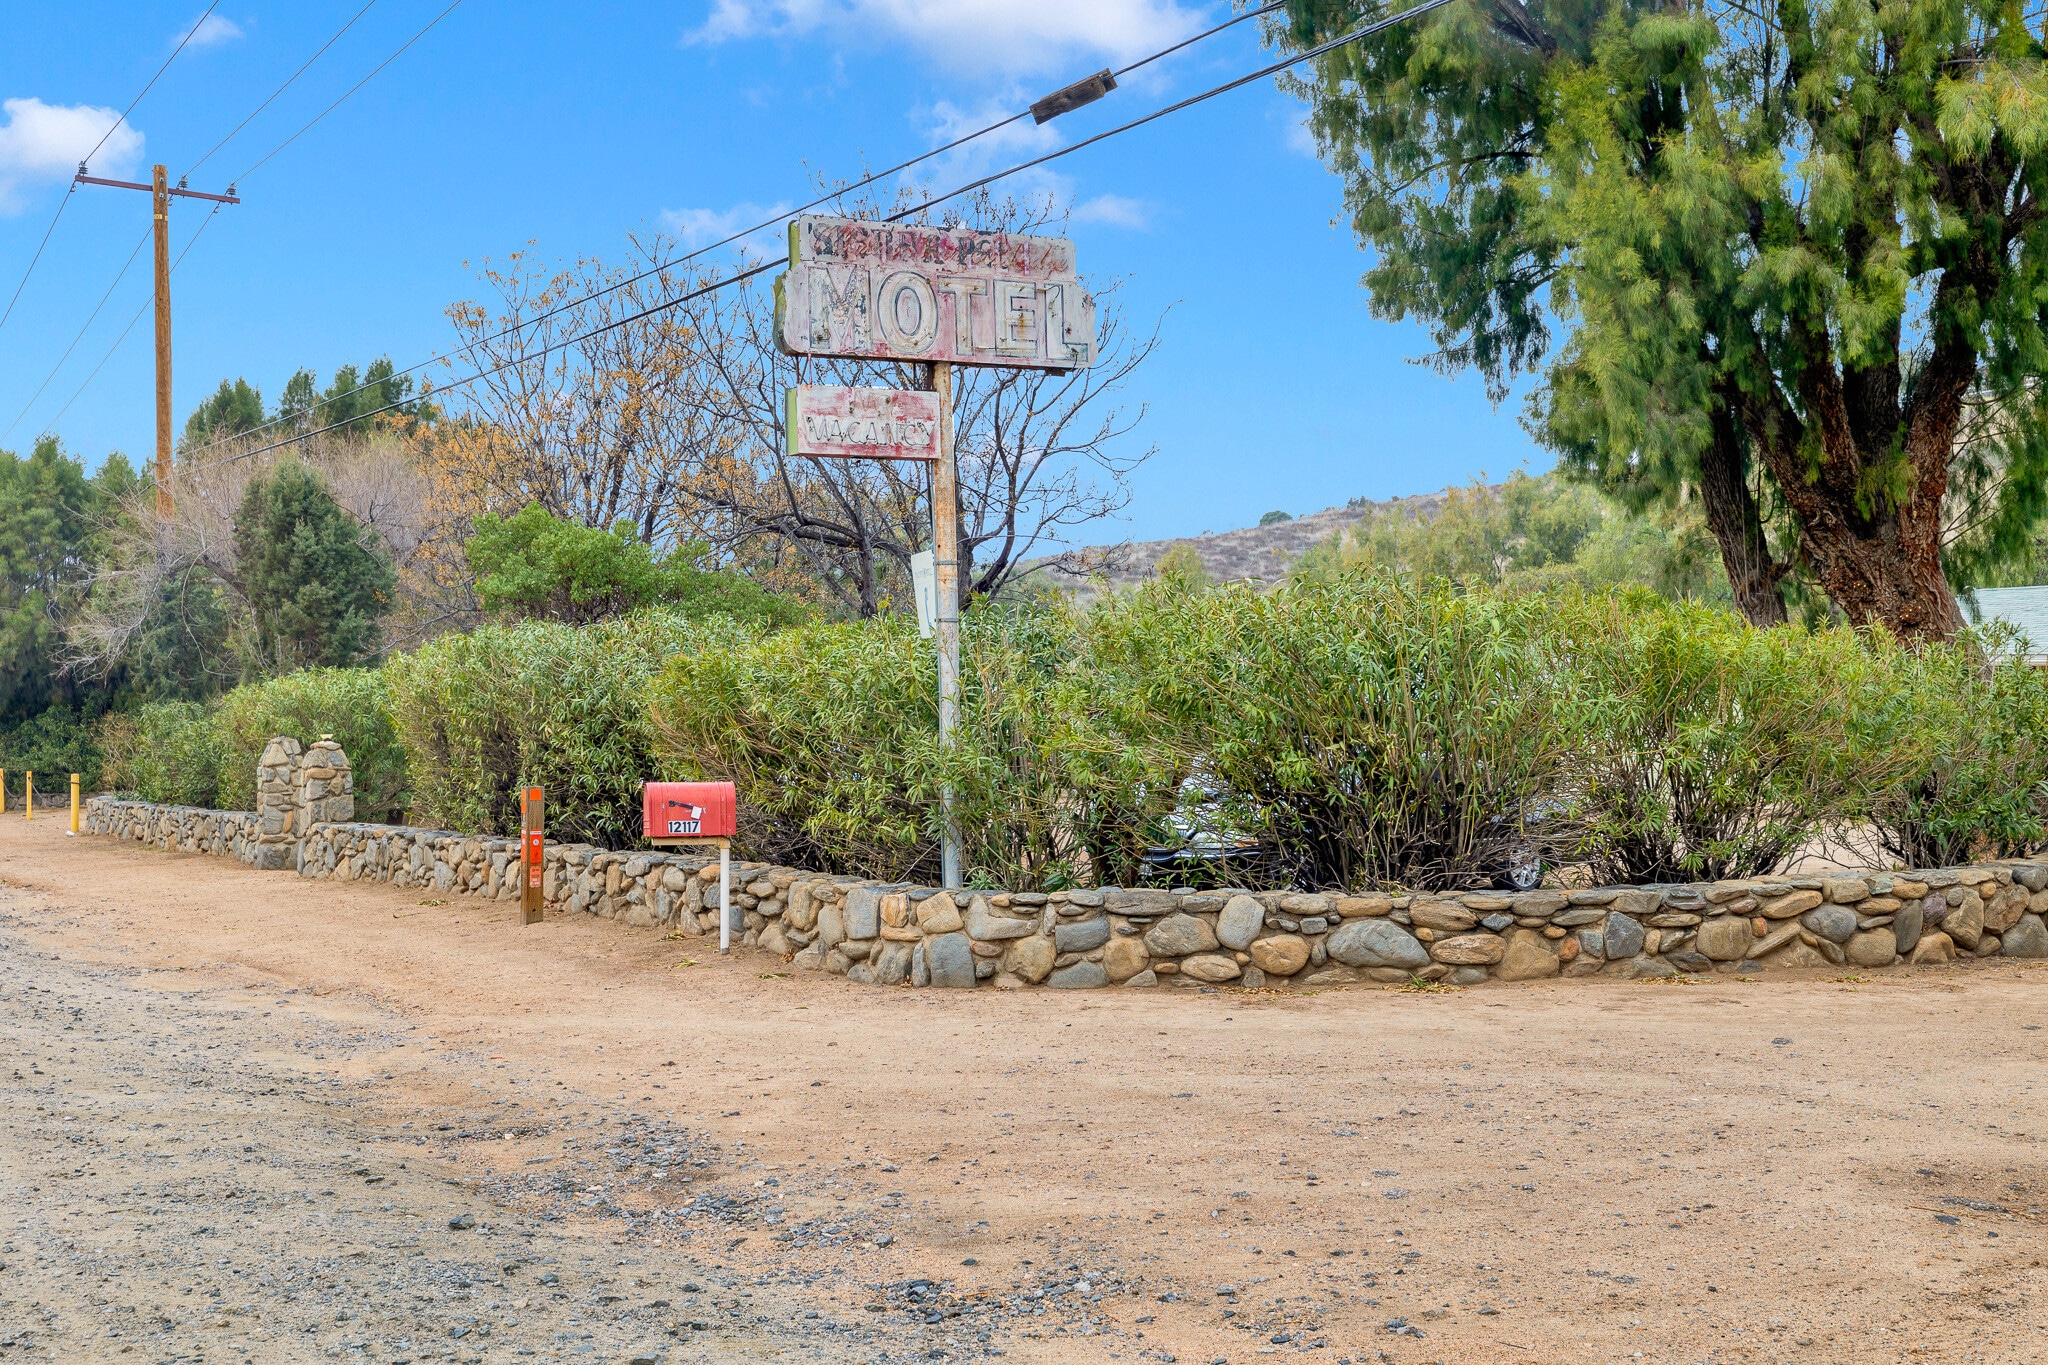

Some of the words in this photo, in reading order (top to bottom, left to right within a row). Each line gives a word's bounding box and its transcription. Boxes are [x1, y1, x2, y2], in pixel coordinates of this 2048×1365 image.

[808, 266, 1088, 361] MOTEL
[804, 416, 936, 446] VACANCY
[668, 821, 699, 833] 12117
